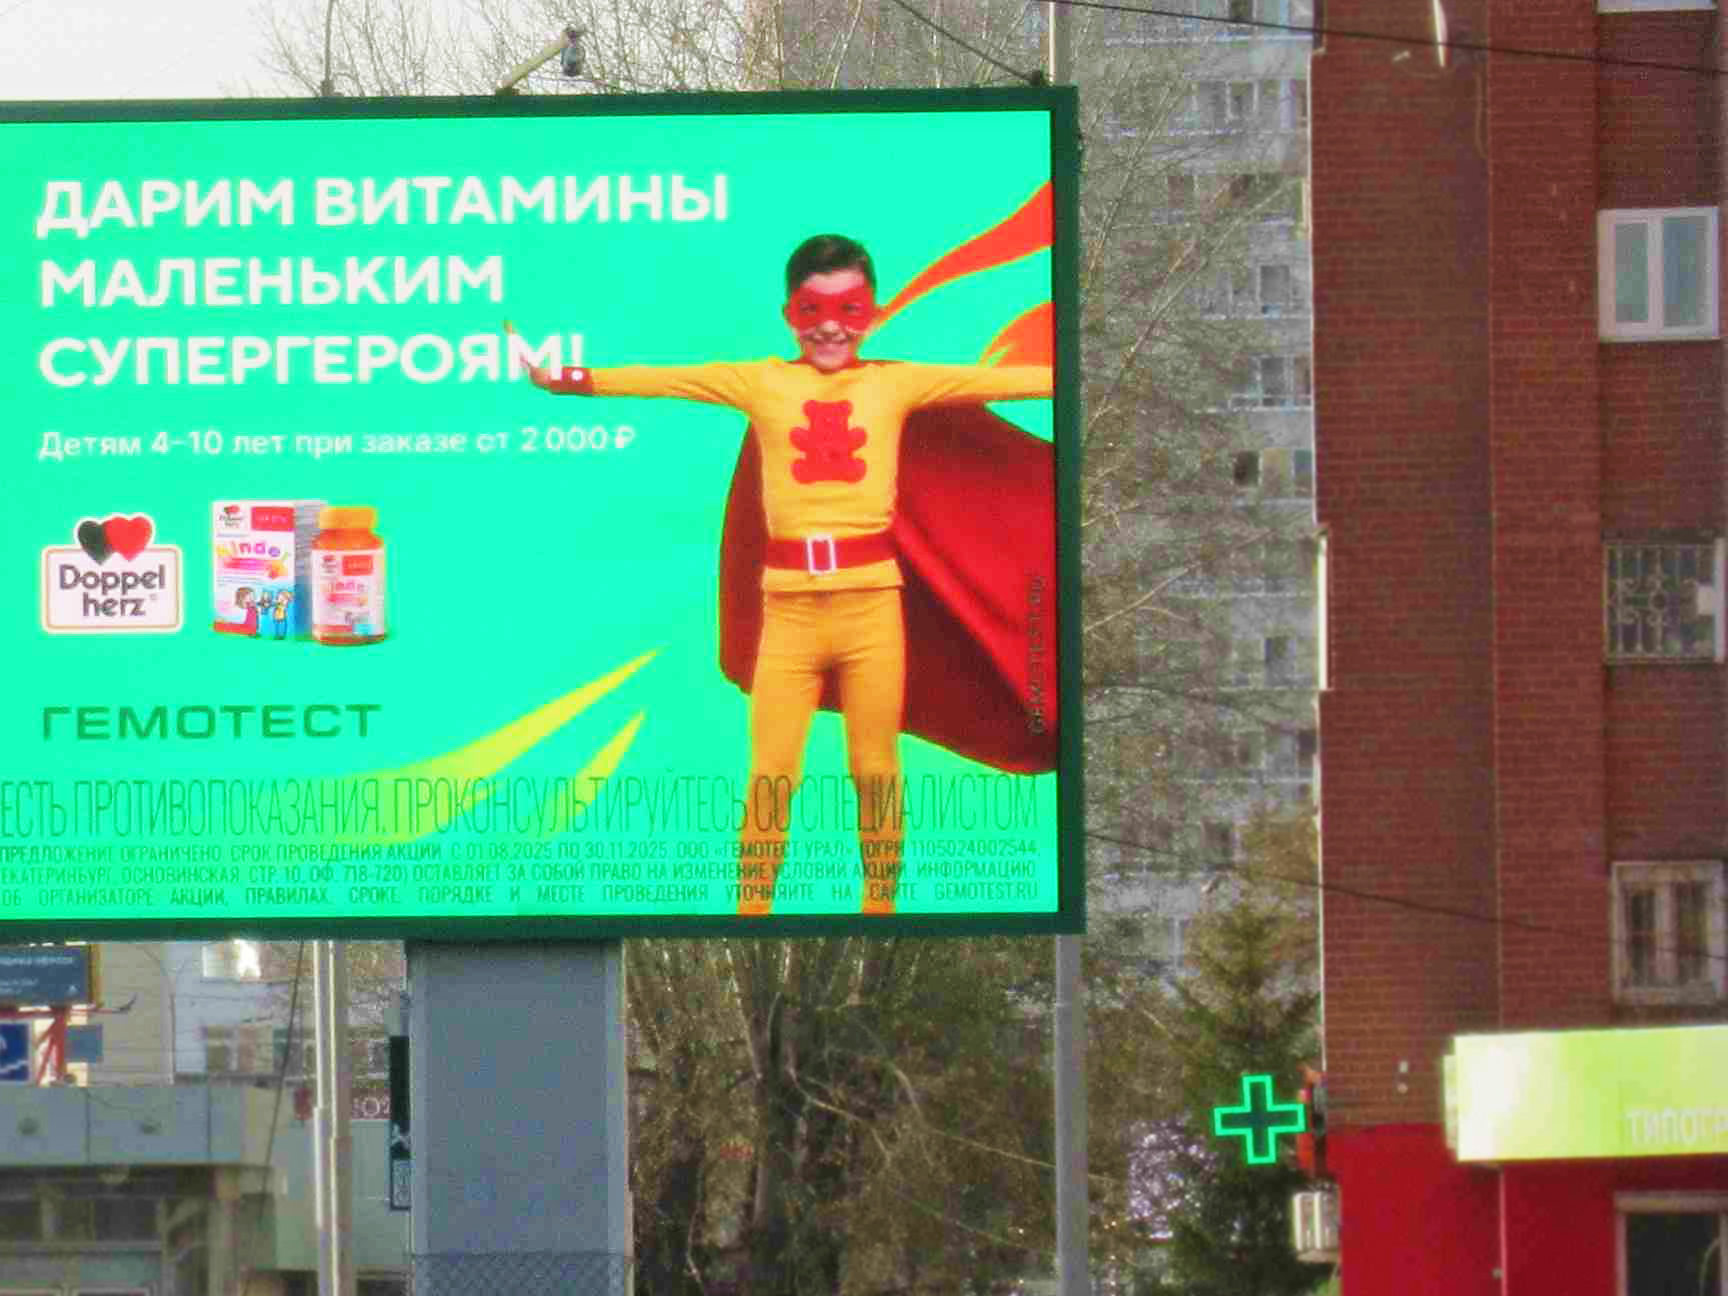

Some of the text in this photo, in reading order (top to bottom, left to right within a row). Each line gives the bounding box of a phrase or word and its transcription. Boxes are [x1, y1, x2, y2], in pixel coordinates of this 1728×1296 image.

[36, 174, 728, 238] ДАРИМ ВИТАМИНЫ
[40, 255, 503, 307] МАЛЕНЬКИМ
[39, 333, 584, 386] СУПЕРГЕРОЯМ!
[38, 431, 140, 461] Детям
[232, 434, 287, 455] лет
[295, 433, 352, 460] при
[362, 432, 466, 454] заказе
[476, 432, 508, 454] от
[59, 564, 165, 595] Doppel
[43, 704, 383, 740] ГЕМОТЕСТ
[1, 779, 66, 838] ЕСТЬ
[394, 768, 748, 837] ПРОКОНСУЛЬТИРУЙТЕСЬ
[754, 775, 792, 832] СО
[800, 773, 1038, 835] СПЕЦИАЛИСТОМ
[591, 863, 641, 881] ПРАВО
